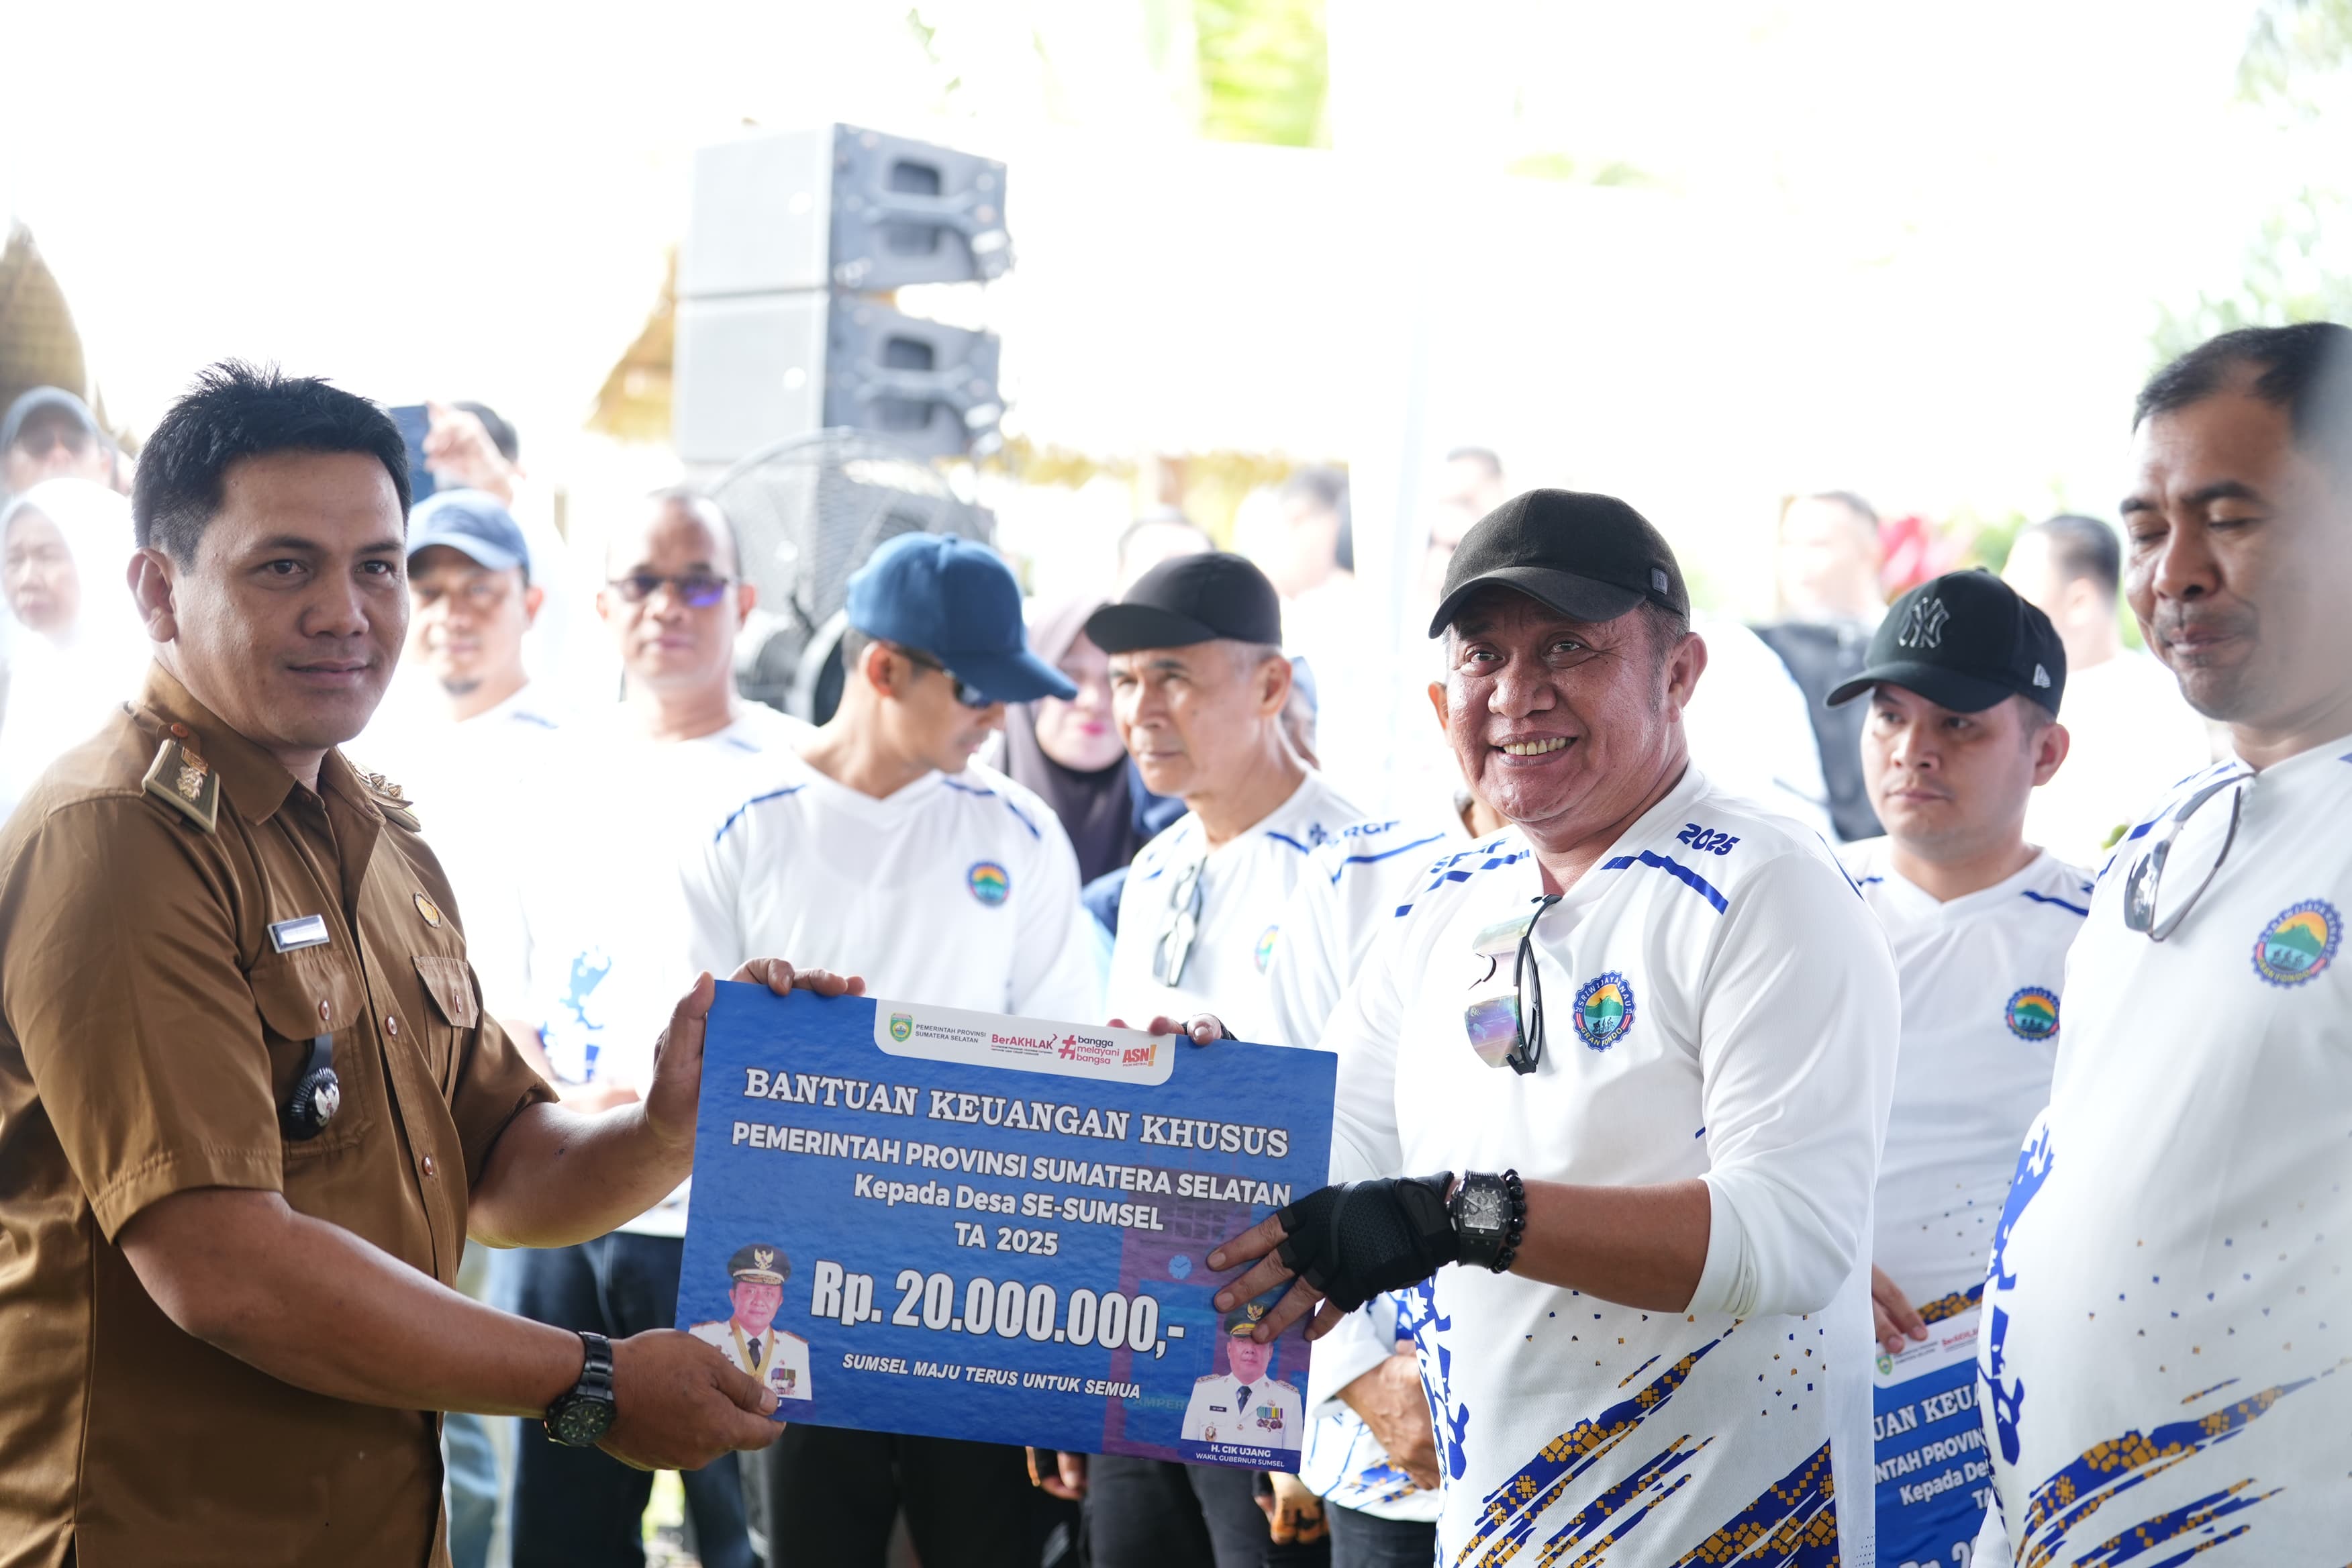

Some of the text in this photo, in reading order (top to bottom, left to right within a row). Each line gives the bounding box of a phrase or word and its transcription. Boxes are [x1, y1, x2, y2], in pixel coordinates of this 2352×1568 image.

[1675, 823, 1741, 856] 2025
[1578, 976, 1619, 1007] SRIWIJAYA
[915, 1030, 979, 1044] SUMATERA SELATAN
[916, 1024, 987, 1038] PEMERINTAH PROVINSI
[991, 1034, 1055, 1049] BerAKHLAK
[1078, 1036, 1114, 1048] bangga
[1581, 1027, 1622, 1046] GRAN FONDO
[1076, 1054, 1111, 1065] bangsa
[1077, 1046, 1120, 1057] melayani
[744, 1068, 1289, 1158] BANTUAN KEUANGAN KHUSUS
[732, 1122, 1291, 1207] PEMERINTAH PROVINSI SUMATERA SELATAN
[854, 1173, 1164, 1230] Kepada Desa SE-SUMSEL
[954, 1222, 1059, 1256] TA 2025
[811, 1260, 1185, 1359] Rp. 20.000.000,-
[842, 1353, 1140, 1399] SUMSEL MAJU TERUS UNTUK SEMUA
[1195, 1453, 1285, 1467] WAKIL GUBERNUR SUMSEL
[1210, 1444, 1271, 1457] H. CIK UJANG
[1922, 1428, 1987, 1467] PROVIN
[1900, 1468, 1964, 1506] Kepada
